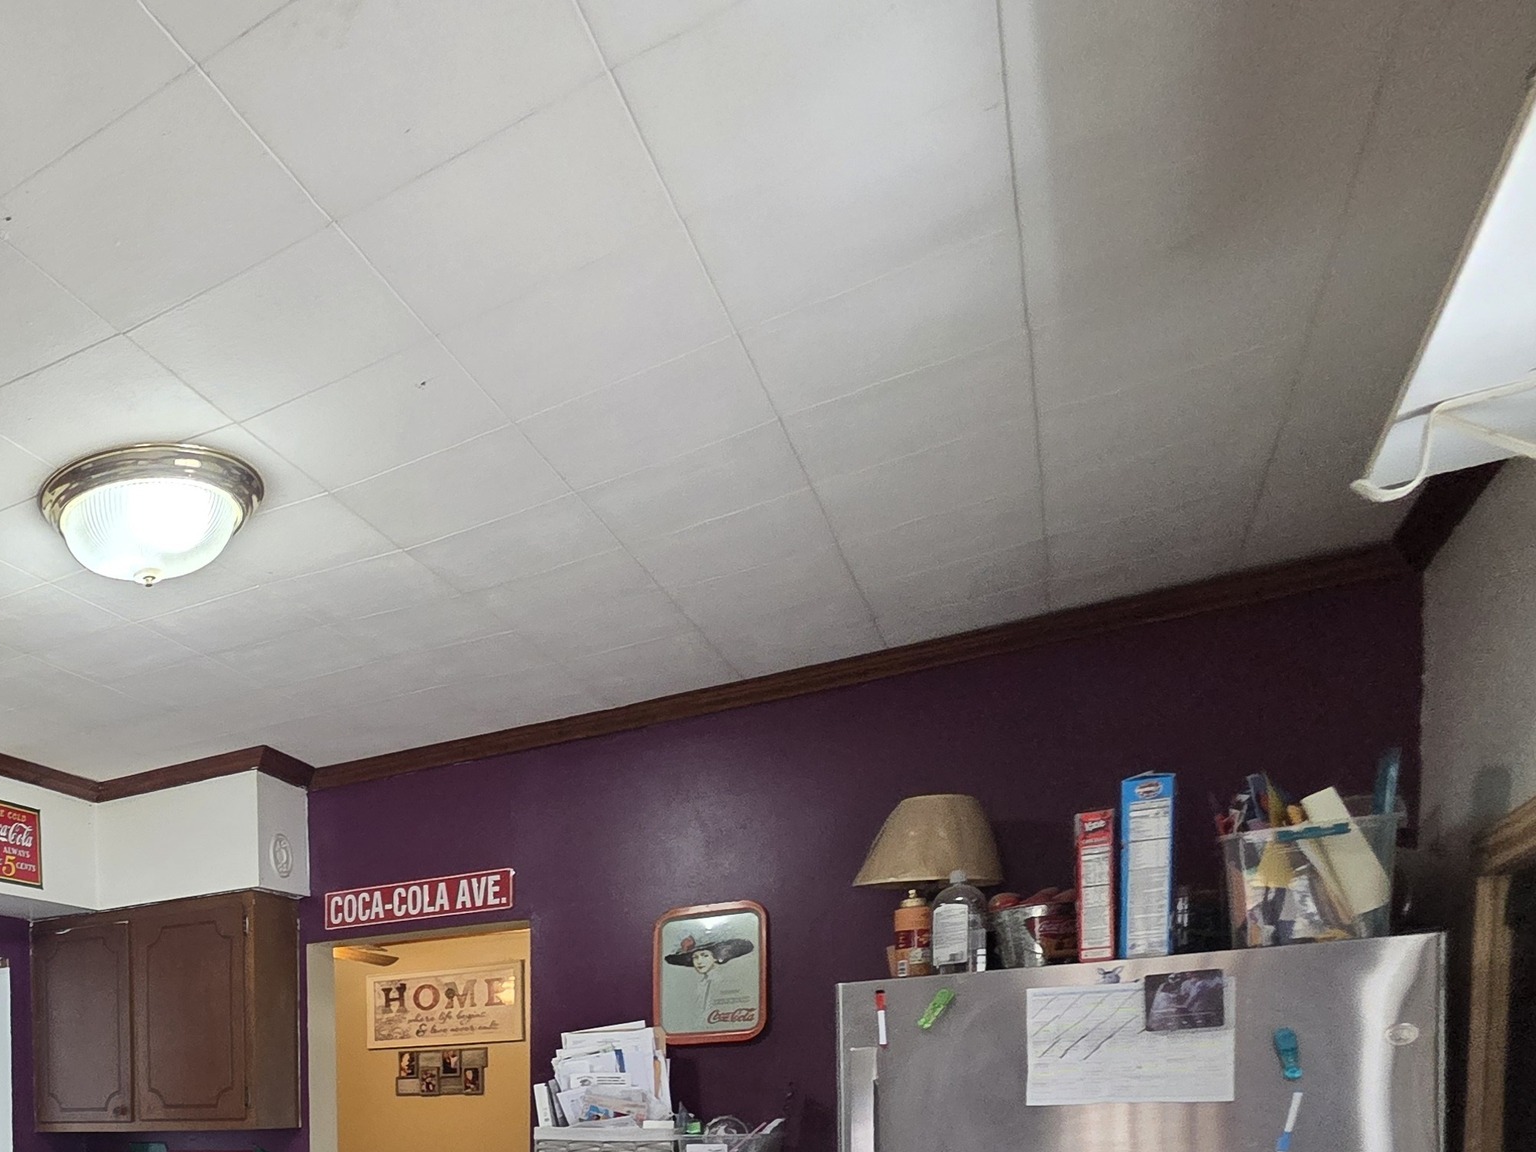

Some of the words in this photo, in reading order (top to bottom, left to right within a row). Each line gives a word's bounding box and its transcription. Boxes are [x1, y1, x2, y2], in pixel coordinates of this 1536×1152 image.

[7, 811, 27, 823] COLD
[3, 846, 31, 859] ALWAYS
[1, 854, 17, 877] 5
[15, 860, 37, 873] CENTS
[329, 881, 451, 925] COCA-COLA
[455, 874, 508, 910] AVE.
[380, 977, 508, 1015] HOME
[707, 1007, 757, 1025] Coca-Cola
